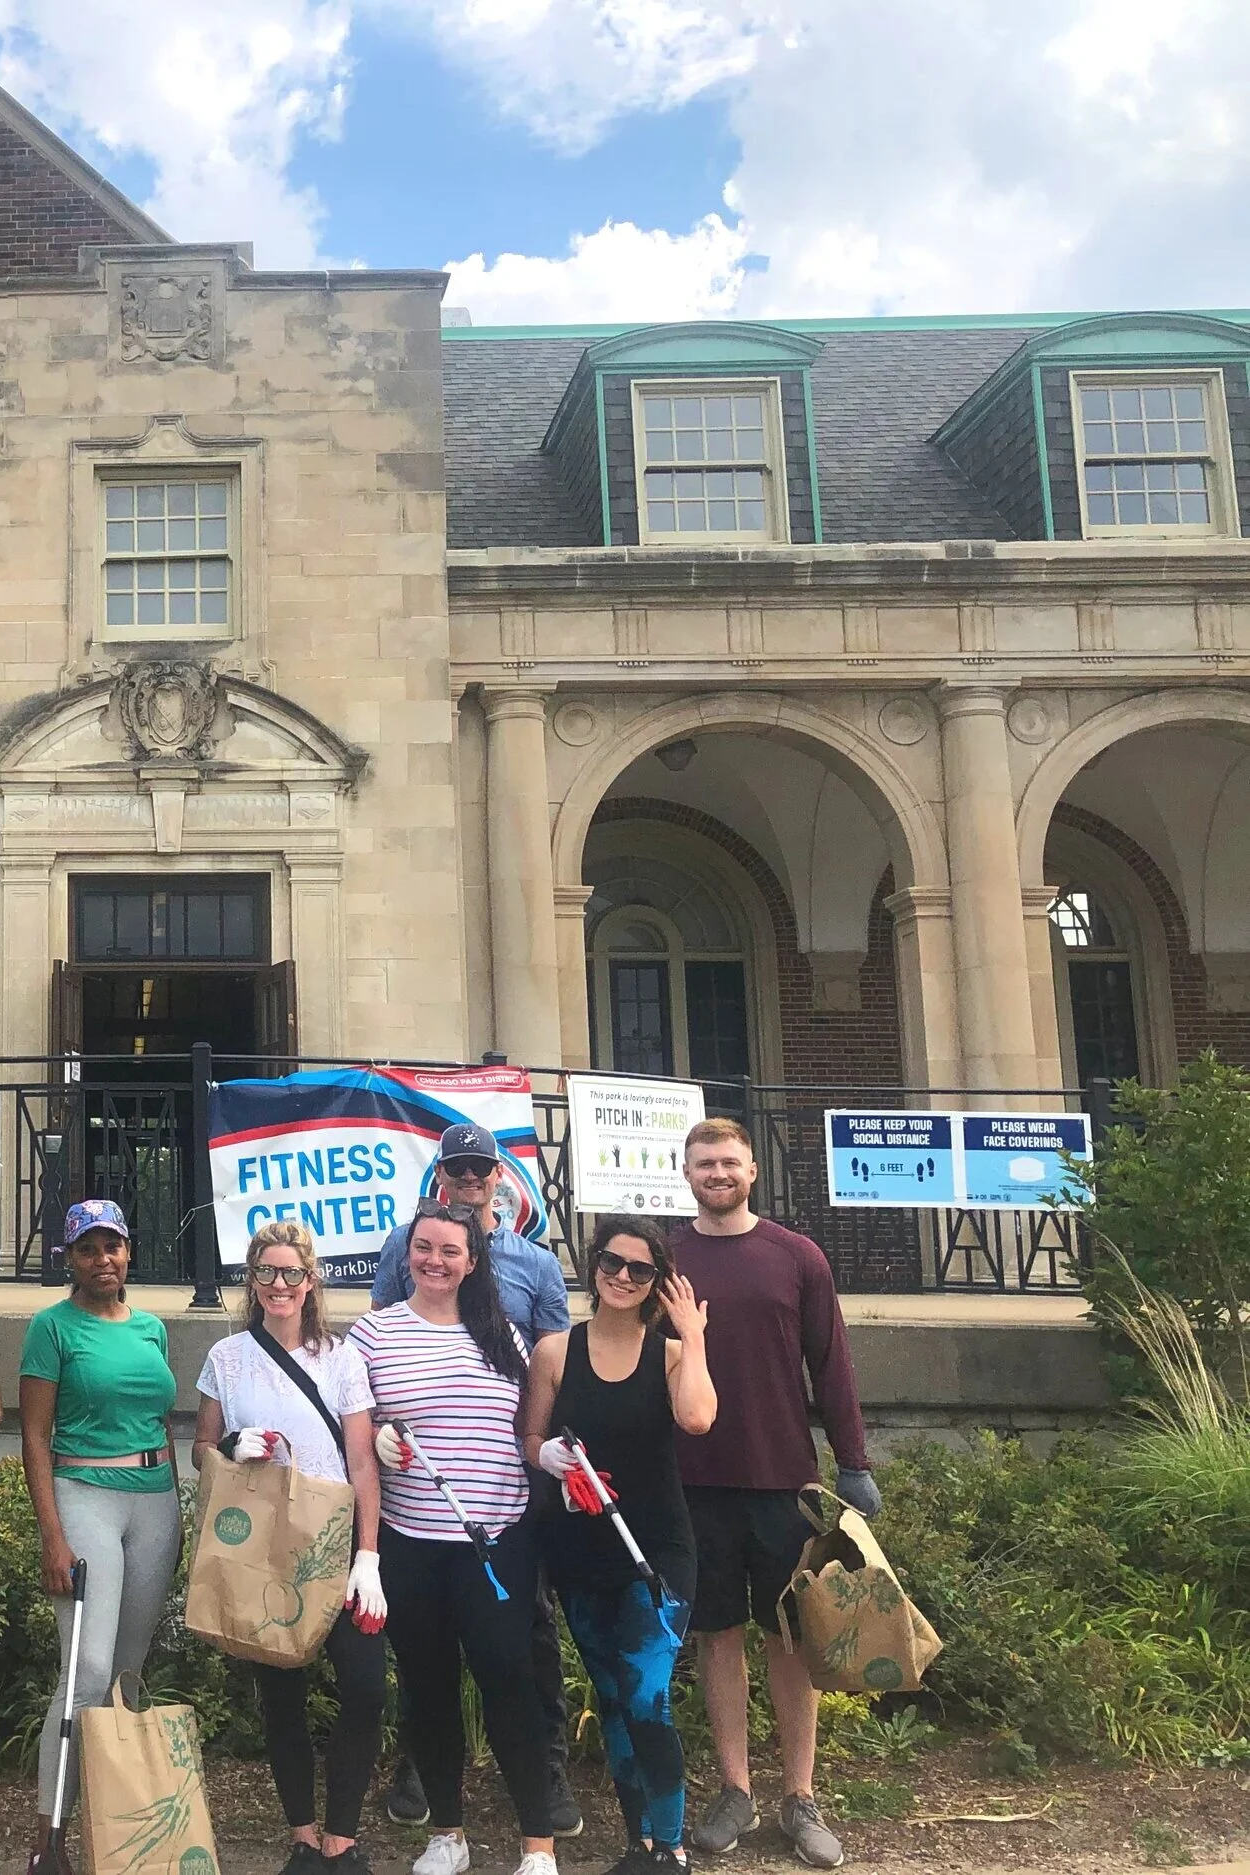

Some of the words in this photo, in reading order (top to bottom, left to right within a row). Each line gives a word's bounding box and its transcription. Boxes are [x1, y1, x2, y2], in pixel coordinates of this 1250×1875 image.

[420, 1076, 458, 1086] CHICAGO
[461, 1077, 484, 1086] PARK
[590, 1091, 604, 1100] This
[605, 1093, 621, 1101] park
[623, 1093, 628, 1101] is
[630, 1093, 654, 1104] lovingly
[672, 1097, 681, 1107] for
[682, 1098, 689, 1107] by
[595, 1107, 628, 1126] PITCH
[632, 1109, 642, 1127] IN
[849, 1119, 882, 1130] PLEASE
[884, 1119, 906, 1131] KEEP
[908, 1119, 933, 1131] YOUR
[991, 1121, 1026, 1133] PLEASE
[1028, 1122, 1056, 1133] WEAR
[853, 1133, 885, 1145] SOCIAL
[886, 1133, 931, 1145] DISTANCE
[983, 1135, 1006, 1147] FACE
[1008, 1136, 1064, 1148] COVERINGS
[238, 1142, 396, 1194] FITNESS
[880, 1163, 886, 1172] 6
[887, 1163, 904, 1172] FEET
[246, 1194, 398, 1240] CENTER
